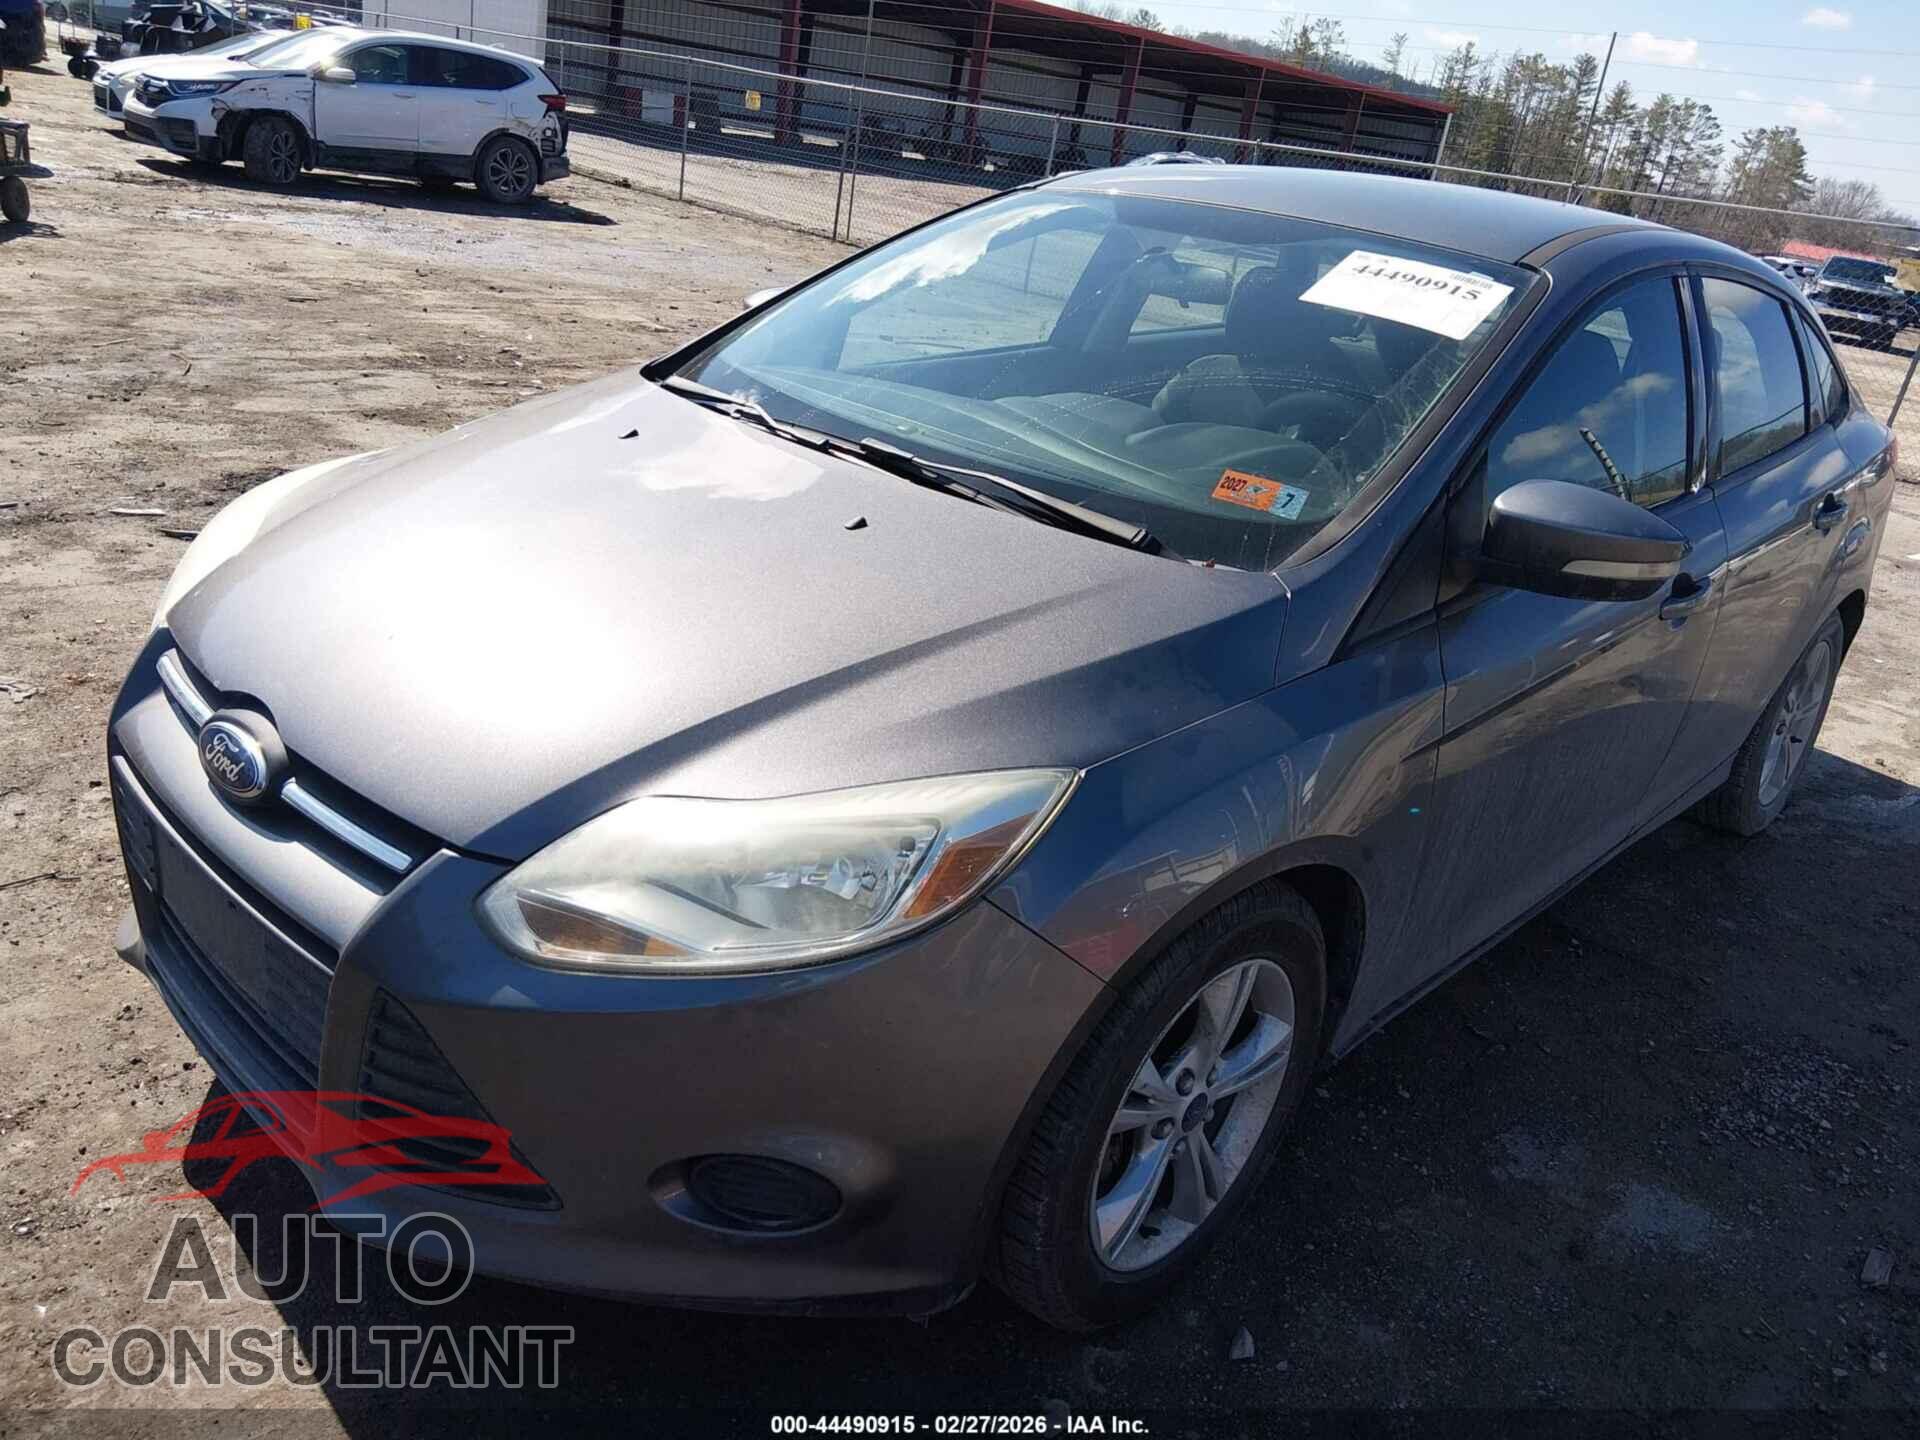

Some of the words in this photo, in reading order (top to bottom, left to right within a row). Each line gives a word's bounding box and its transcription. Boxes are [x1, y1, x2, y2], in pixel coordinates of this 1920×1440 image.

[1352, 264, 1482, 301] 44490915
[1220, 476, 1248, 492] 2027
[1280, 491, 1297, 509] 7
[205, 733, 245, 782] Ford
